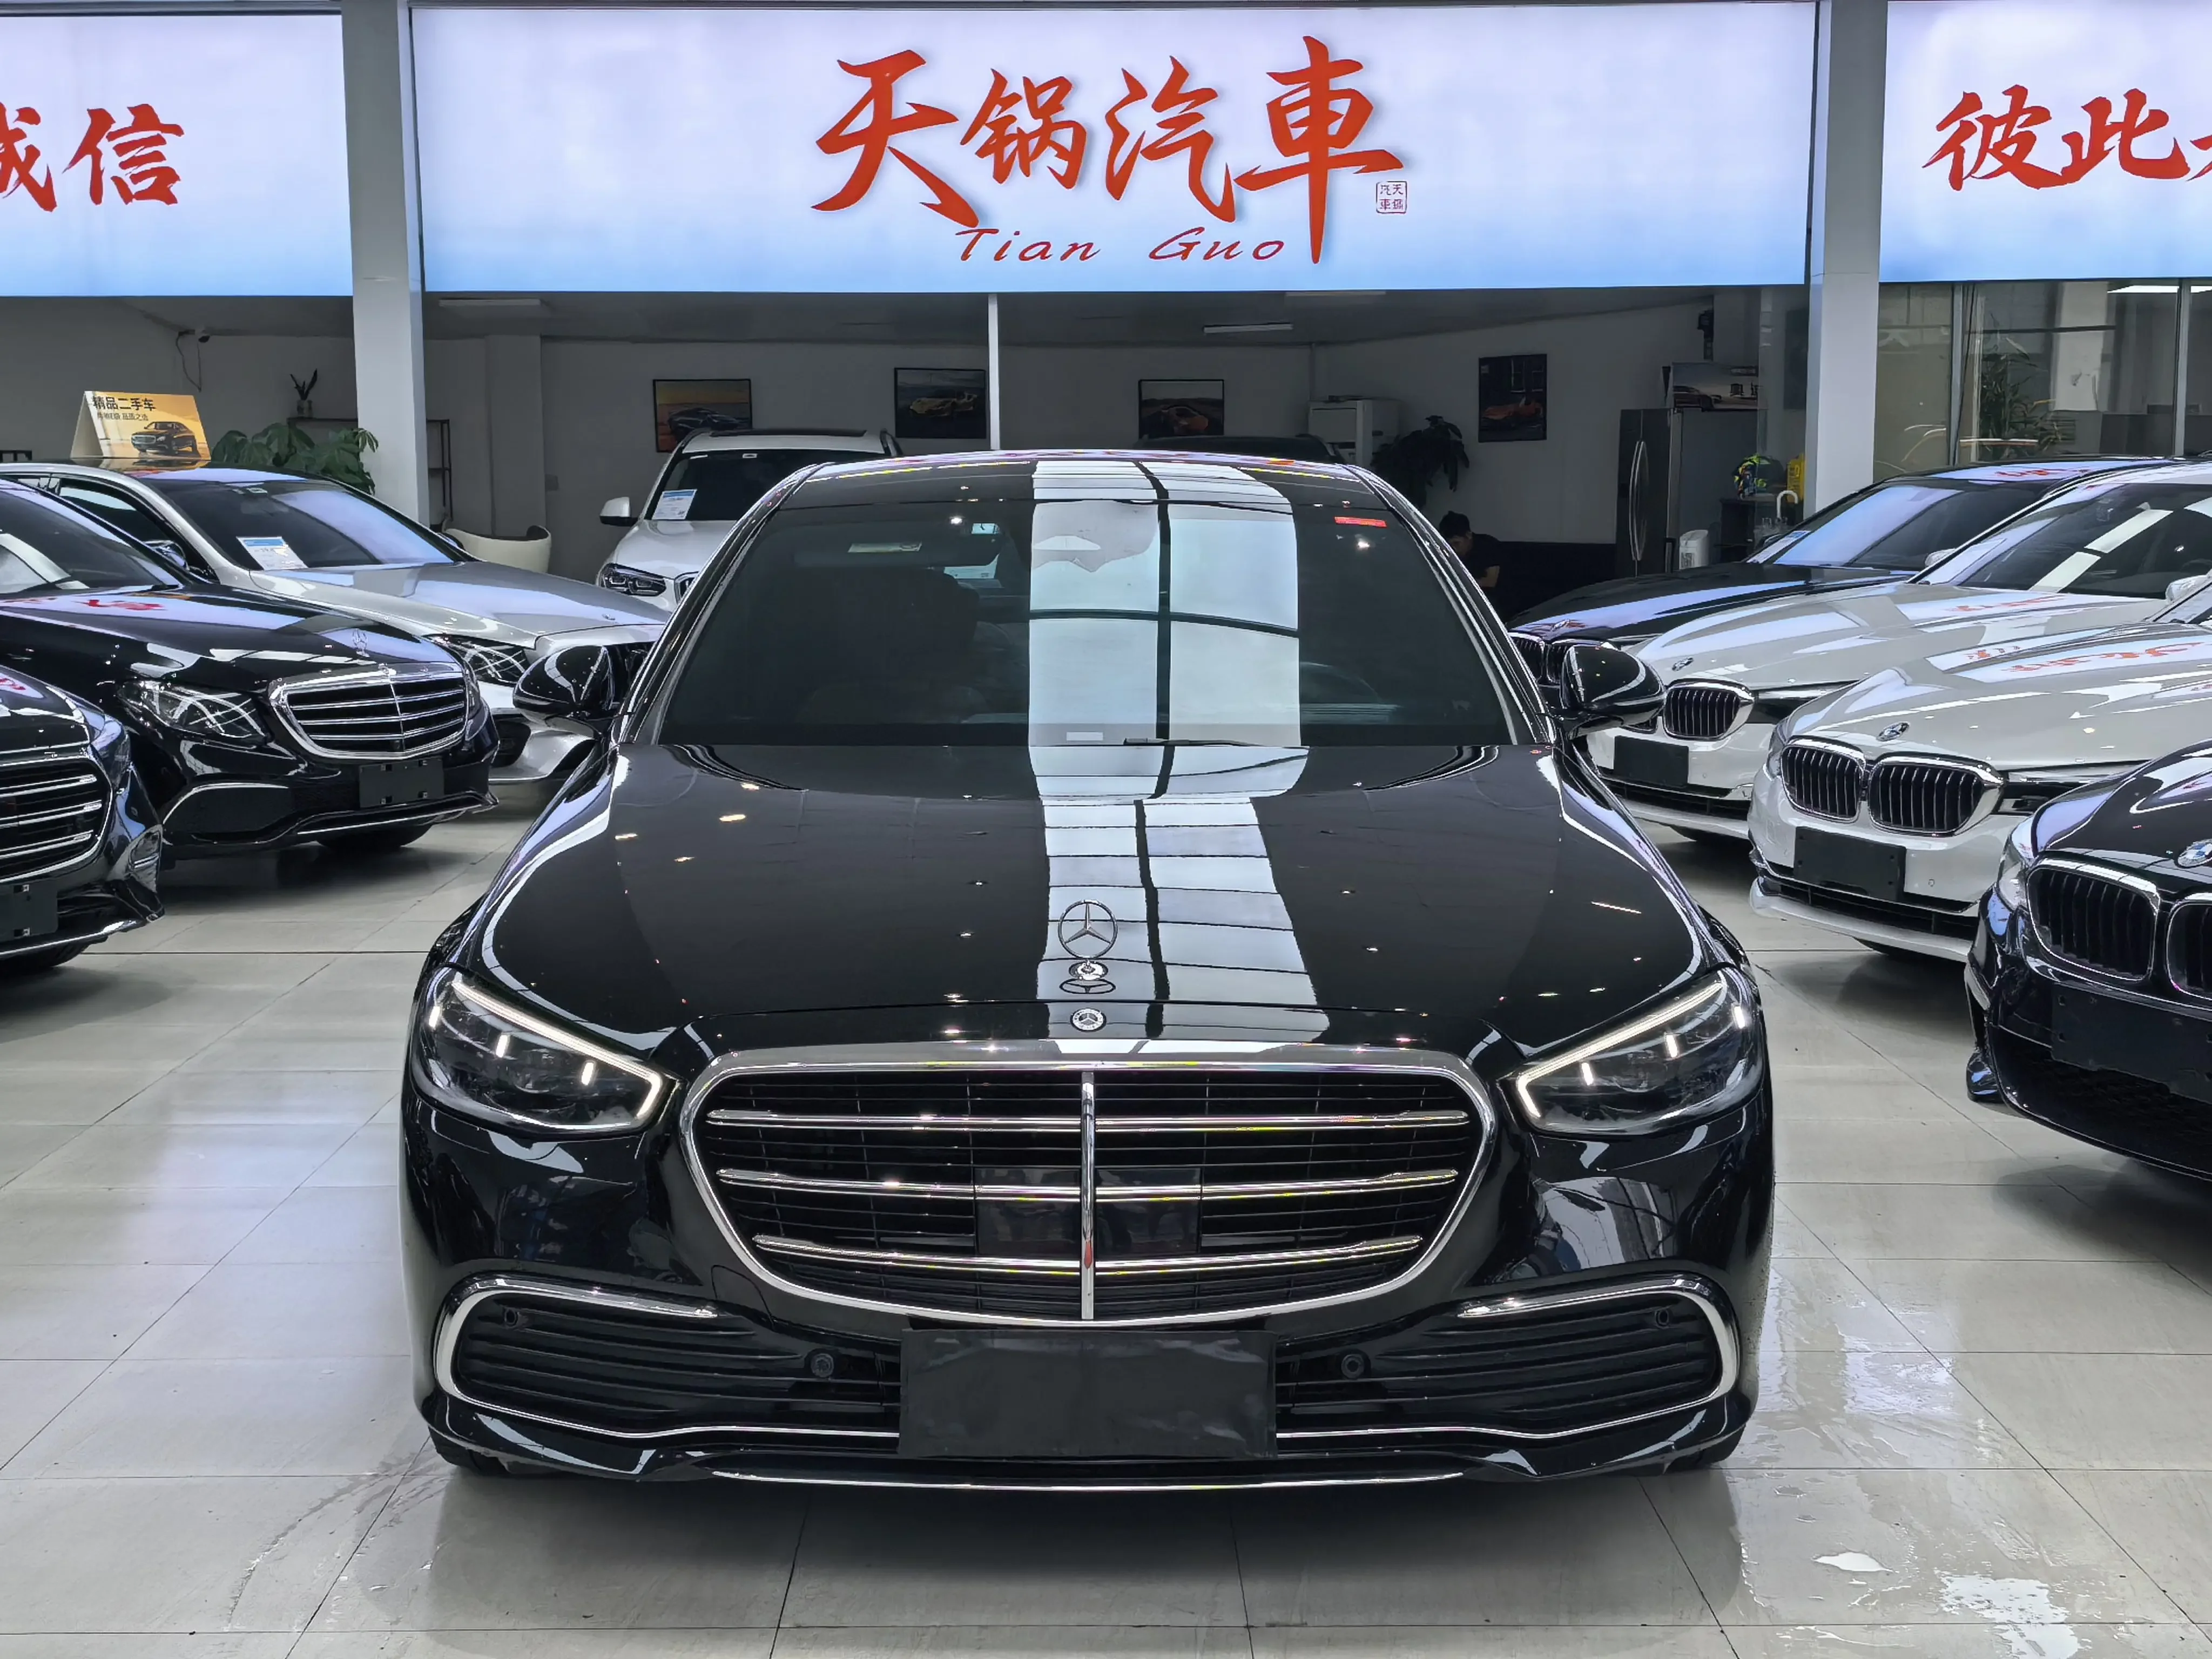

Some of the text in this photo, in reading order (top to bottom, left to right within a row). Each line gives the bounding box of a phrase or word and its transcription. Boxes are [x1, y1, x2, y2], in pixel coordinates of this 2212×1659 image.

[1921, 84, 2212, 192] 彼此
[955, 226, 1285, 262] Tian Guo
[91, 396, 157, 412] 精品二手车
